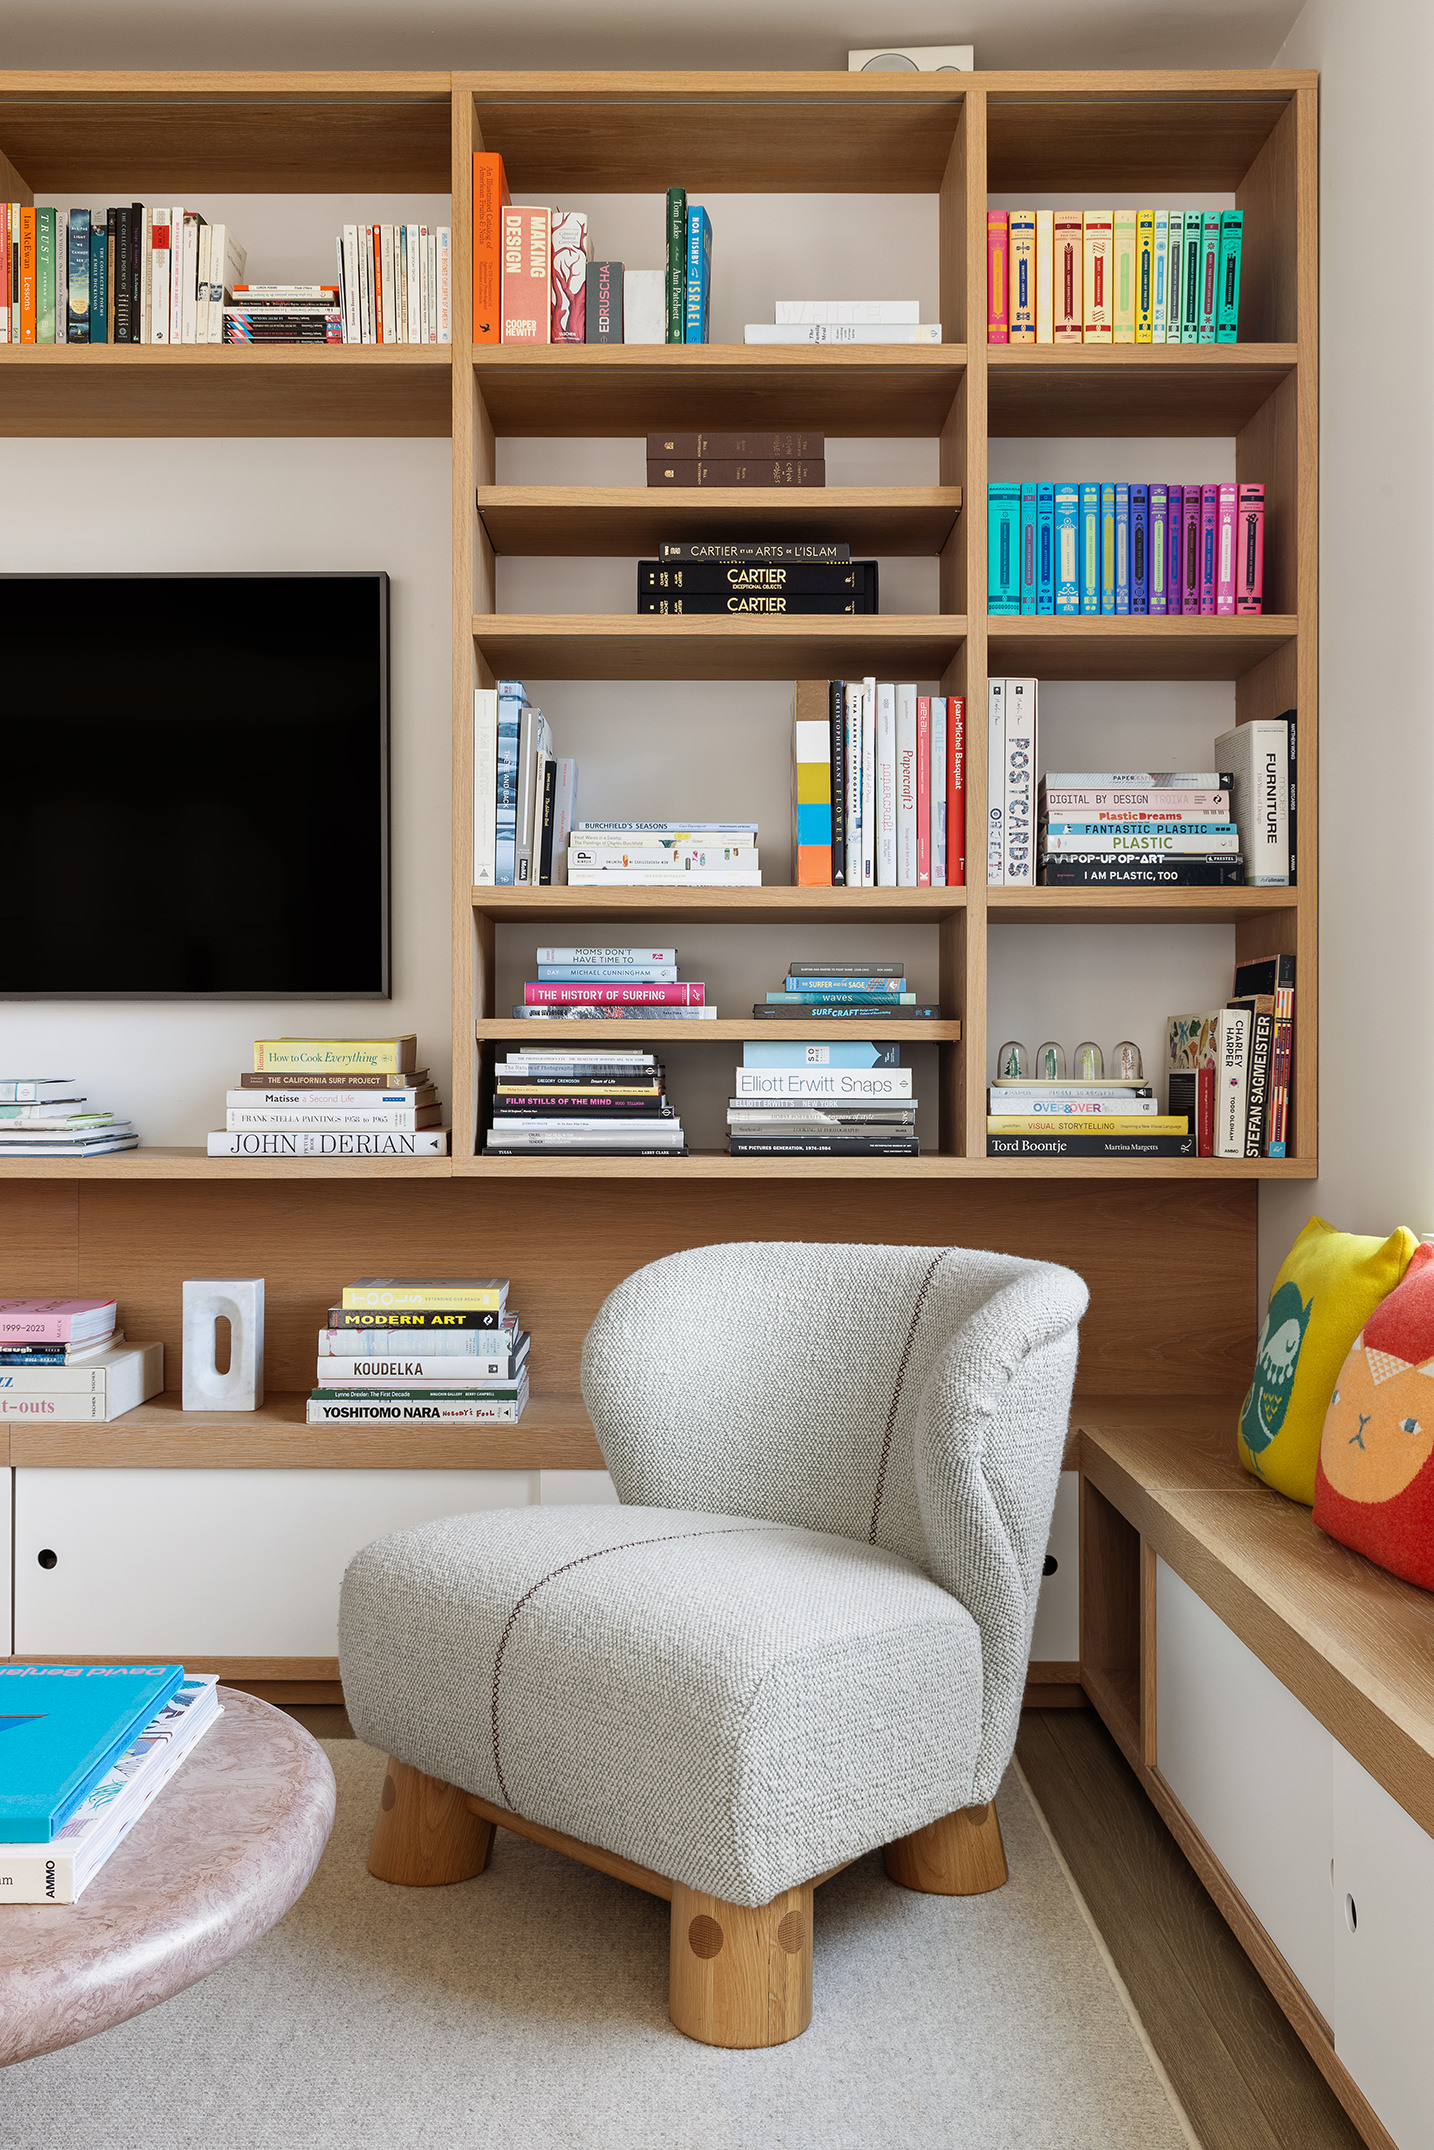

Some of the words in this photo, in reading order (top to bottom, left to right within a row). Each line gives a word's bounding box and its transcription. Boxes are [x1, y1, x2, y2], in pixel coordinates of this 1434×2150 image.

[672, 199, 682, 217] Tom
[24, 215, 32, 229] Ian
[672, 219, 682, 239] Lake
[691, 216, 700, 234] NOA
[40, 214, 49, 264] TRUST
[506, 215, 522, 274] DESIGN
[24, 232, 32, 269] McEwan
[530, 216, 546, 279] MAKING
[691, 236, 700, 265] TISHBY
[672, 268, 682, 285] Ann
[24, 277, 32, 311] Lessons
[672, 287, 682, 320] Patchett
[688, 281, 701, 328] ISRAEL
[505, 319, 537, 328] COOPER
[505, 328, 537, 337] HEWITT
[690, 546, 738, 557] CARTIER
[755, 546, 783, 557] ARTS
[727, 568, 787, 584] CARTIER
[727, 597, 787, 612] CARTIER
[935, 711, 944, 753] TACTILE
[953, 700, 963, 750] Jean-Michel
[502, 750, 510, 772] THERE
[900, 750, 914, 803] Papercraft
[953, 752, 963, 790] Basquiat
[502, 774, 510, 789] AND
[502, 790, 510, 808] BACK
[1050, 794, 1090, 804] DIGITAL
[1095, 794, 1107, 804] BY
[1113, 794, 1149, 804] DESIGN
[1266, 753, 1277, 844] FURNITURE
[1008, 738, 1030, 877] POSTCARDS
[584, 822, 633, 830] BURCHFIELD'S
[635, 822, 668, 830] SEASONS
[1084, 825, 1150, 834] FANTASTIC
[1157, 825, 1208, 834] PLASTIC
[1113, 837, 1173, 849] PLASTIC
[1084, 871, 1088, 880] I
[1090, 871, 1106, 880] AM
[1109, 871, 1156, 882] PLASTIC,
[1157, 871, 1178, 880] TOO
[572, 956, 597, 964] HAVE
[600, 956, 620, 964] TIME
[622, 956, 634, 964] TO
[538, 990, 557, 1000] THE
[561, 990, 603, 1000] HISTORY
[606, 990, 619, 1000] OF
[622, 990, 665, 1000] SURFING
[822, 994, 853, 1002] waves
[1226, 1027, 1234, 1068] HARPER
[1234, 1020, 1244, 1068] CHARLEY
[268, 1052, 289, 1062] How
[290, 1054, 299, 1062] to
[300, 1052, 323, 1062] Cook
[324, 1052, 378, 1066] Everything
[1251, 1016, 1271, 1104] SAGMEISTER
[268, 1076, 282, 1085] THE
[283, 1076, 327, 1085] CALIFORNIA
[328, 1076, 346, 1085] SURF
[348, 1076, 381, 1085] PROJECT
[742, 1076, 784, 1092] Elliott
[788, 1076, 834, 1092] Erwitt
[840, 1076, 892, 1095] Snaps
[265, 1094, 300, 1103] Matisse
[309, 1094, 338, 1103] Second
[341, 1094, 354, 1103] Life
[241, 1114, 268, 1123] FRANK
[270, 1114, 300, 1123] STELLA
[302, 1114, 341, 1123] PAINTINGS
[344, 1114, 360, 1123] 1958
[372, 1114, 388, 1123] 1965
[1028, 1122, 1055, 1130] VISUAL
[1058, 1122, 1115, 1130] STORYTELLING
[1246, 1105, 1260, 1158] STEFAN
[230, 1134, 298, 1154] JOHN
[319, 1134, 416, 1154] DERIAN
[992, 1140, 1018, 1151] Tord
[1022, 1140, 1068, 1153] Boontje
[1131, 1143, 1158, 1152] Margetts
[344, 1315, 425, 1324] MODERN
[431, 1315, 467, 1324] ART
[354, 1362, 424, 1376] KOUDELKA
[323, 1407, 401, 1418] YOSHITOMO
[404, 1407, 440, 1418] NARA
[86, 1668, 167, 1677] David
[46, 1860, 56, 1898] AMMO
